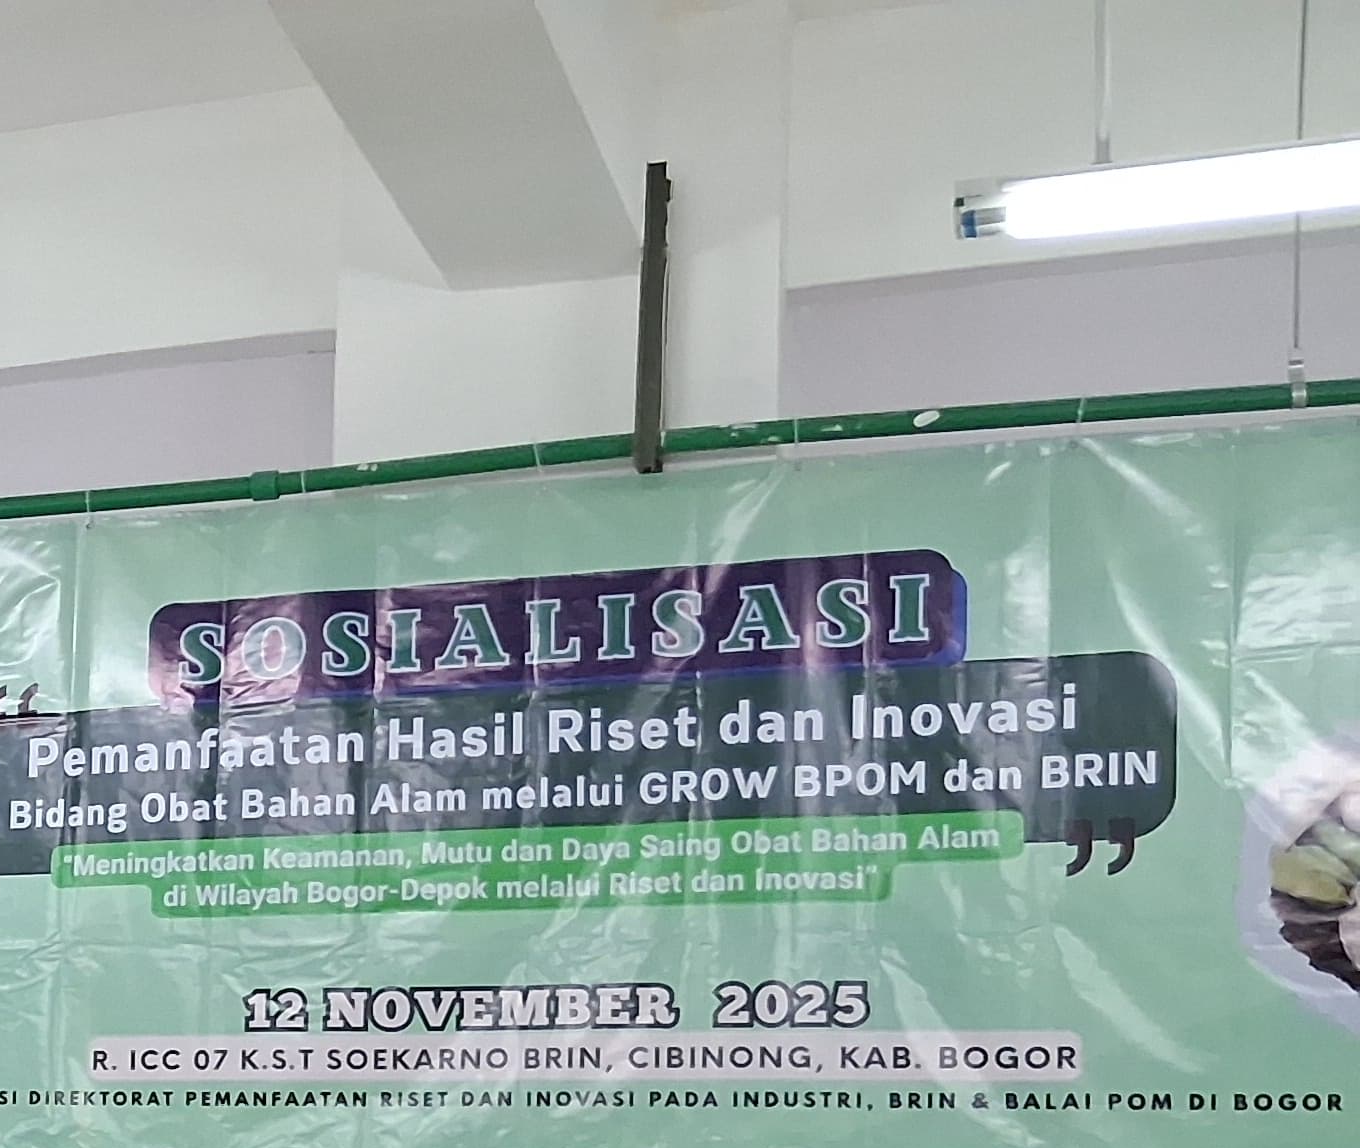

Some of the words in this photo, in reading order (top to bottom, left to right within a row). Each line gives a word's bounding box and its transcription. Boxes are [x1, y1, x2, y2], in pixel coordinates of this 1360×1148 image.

[177, 573, 930, 688] SOSIALISASI
[27, 727, 365, 778] Pemanfaatan
[388, 711, 524, 761] Hasil
[548, 706, 698, 753] Riset
[719, 699, 824, 744] dan
[851, 682, 1077, 739] Inovasi
[9, 797, 127, 833] Bidang
[140, 792, 228, 823] Obat
[241, 787, 356, 820] Bahan
[370, 782, 466, 815] Alam
[482, 774, 623, 810] melalui
[639, 765, 777, 805] GROW
[794, 759, 926, 798] BPOM
[943, 758, 1022, 793] dan
[1041, 749, 1157, 788] BRIN
[263, 846, 412, 869] Keamanan,
[422, 841, 492, 865] Mutu
[501, 839, 552, 862] dan
[562, 837, 630, 866] Daya
[640, 832, 721, 861] Saing
[731, 829, 802, 855] Obat
[812, 827, 907, 853] Bahan
[917, 823, 1000, 850] Alam
[163, 886, 186, 907] di
[196, 882, 298, 910] Wilayah
[307, 877, 488, 908] Bogor-Depok
[497, 872, 600, 898] melalui
[609, 871, 682, 896] Riset
[691, 869, 744, 893] dan
[244, 988, 308, 1032] 12
[323, 982, 680, 1033] NOVEMBER
[712, 981, 870, 1028] 2025
[92, 1049, 117, 1071] R.
[130, 1049, 181, 1071] ICC
[193, 1050, 228, 1071] 07
[241, 1049, 314, 1071] K.S.T
[327, 1047, 508, 1070] SOEKARNO
[524, 1045, 613, 1073] BRIN,
[628, 1045, 823, 1073] CIBINONG,
[840, 1045, 922, 1070] KAB.
[938, 1045, 1078, 1070] BOGOR
[29, 1090, 175, 1107] DIREKTORAT
[185, 1090, 367, 1107] PEMANFAATAN
[380, 1091, 449, 1107] RISET
[461, 1091, 513, 1107] DAN
[526, 1091, 636, 1107] INOVASI
[650, 1091, 719, 1107] PADA
[733, 1091, 873, 1110] INDUSTRI,
[888, 1092, 956, 1110] BRIN
[970, 1092, 990, 1110] &
[1005, 1093, 1092, 1110] BALAI
[1108, 1093, 1173, 1110] POM
[1188, 1093, 1217, 1111] DI
[1233, 1094, 1343, 1112] BOGOR
